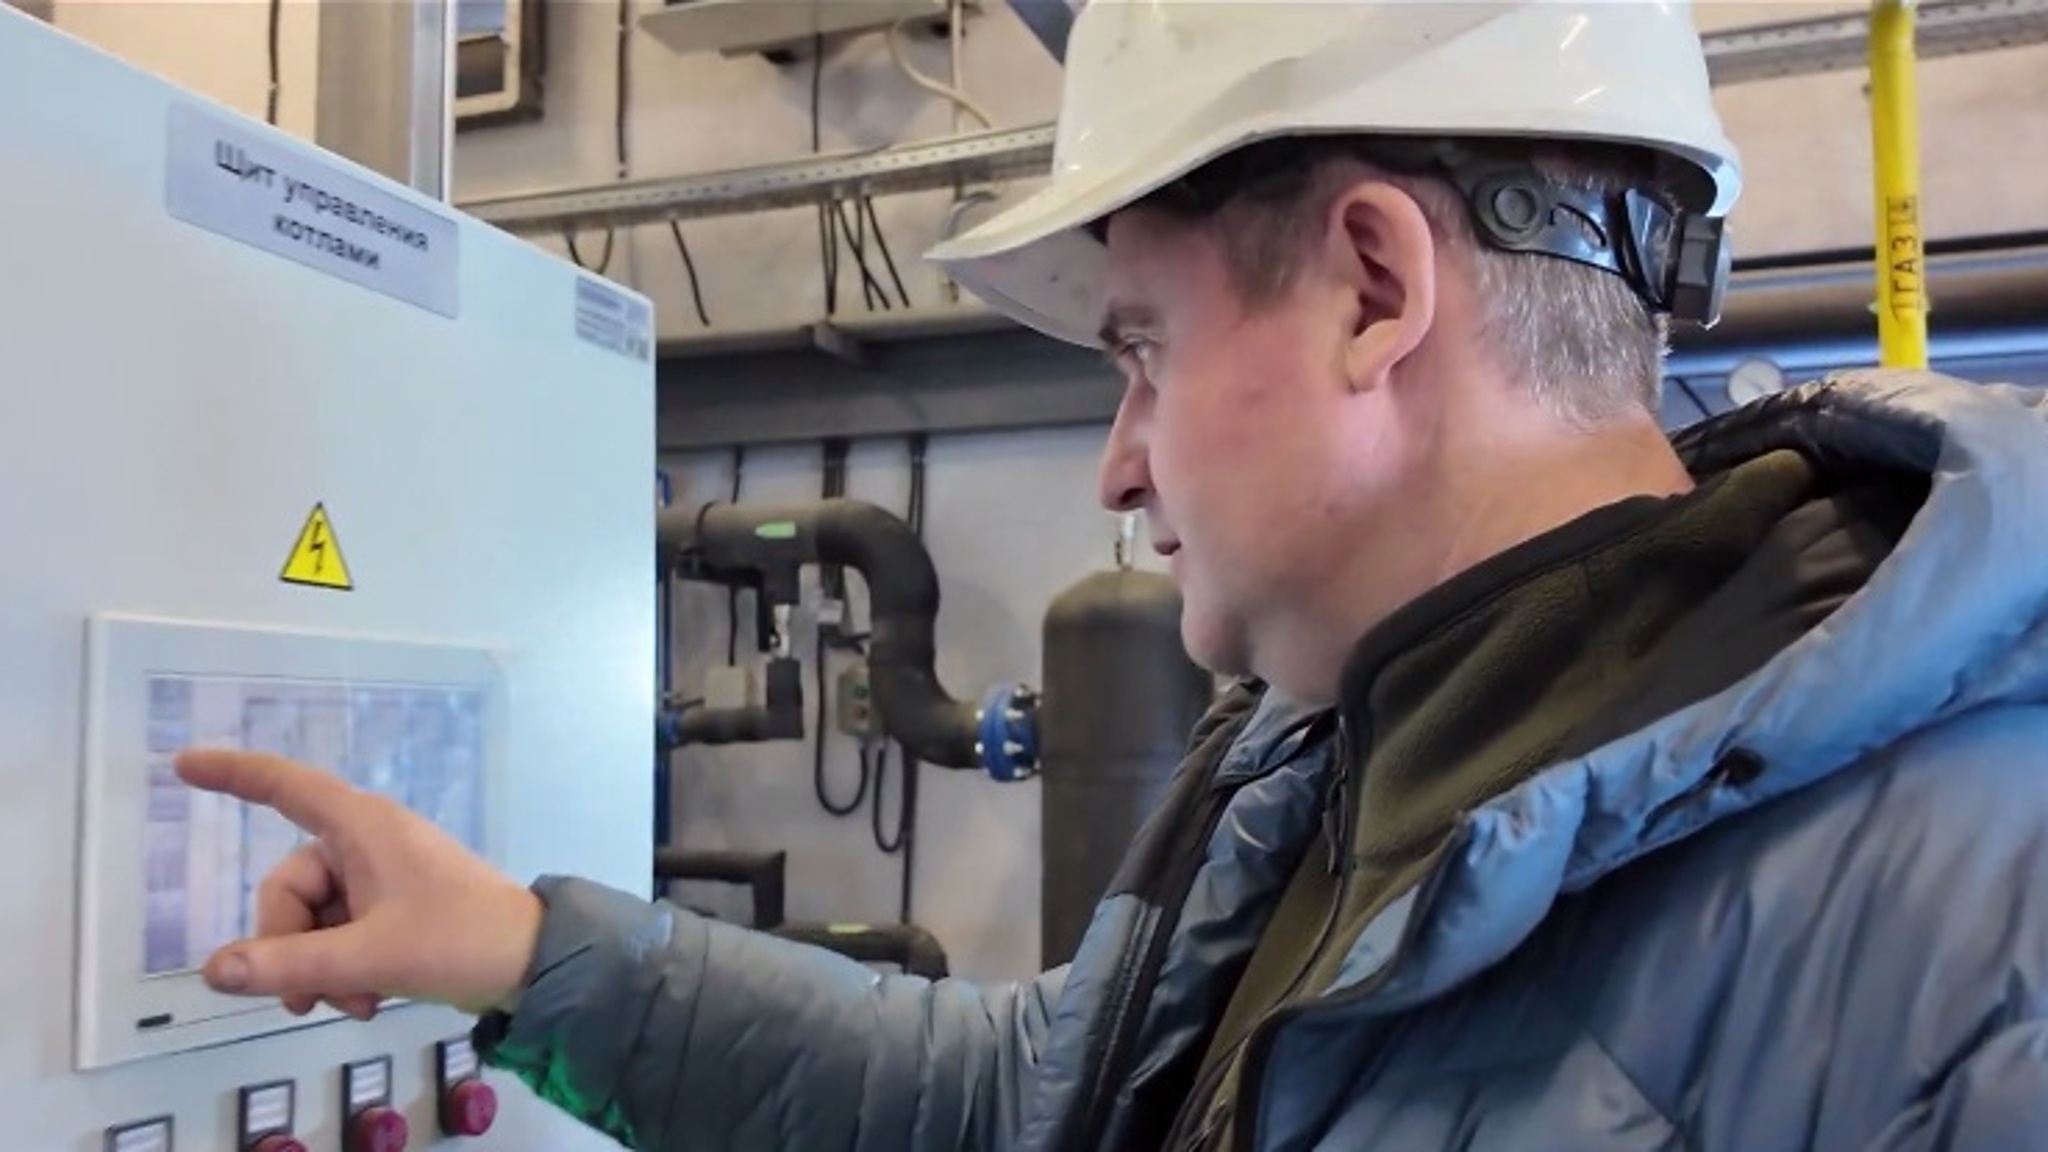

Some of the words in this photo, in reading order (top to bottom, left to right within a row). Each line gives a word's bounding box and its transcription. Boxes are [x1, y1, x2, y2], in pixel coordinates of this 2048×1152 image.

[215, 139, 276, 187] Щит
[284, 176, 429, 250] управления
[273, 213, 380, 269] котлами
[1892, 235, 1919, 292] ГАЗ
